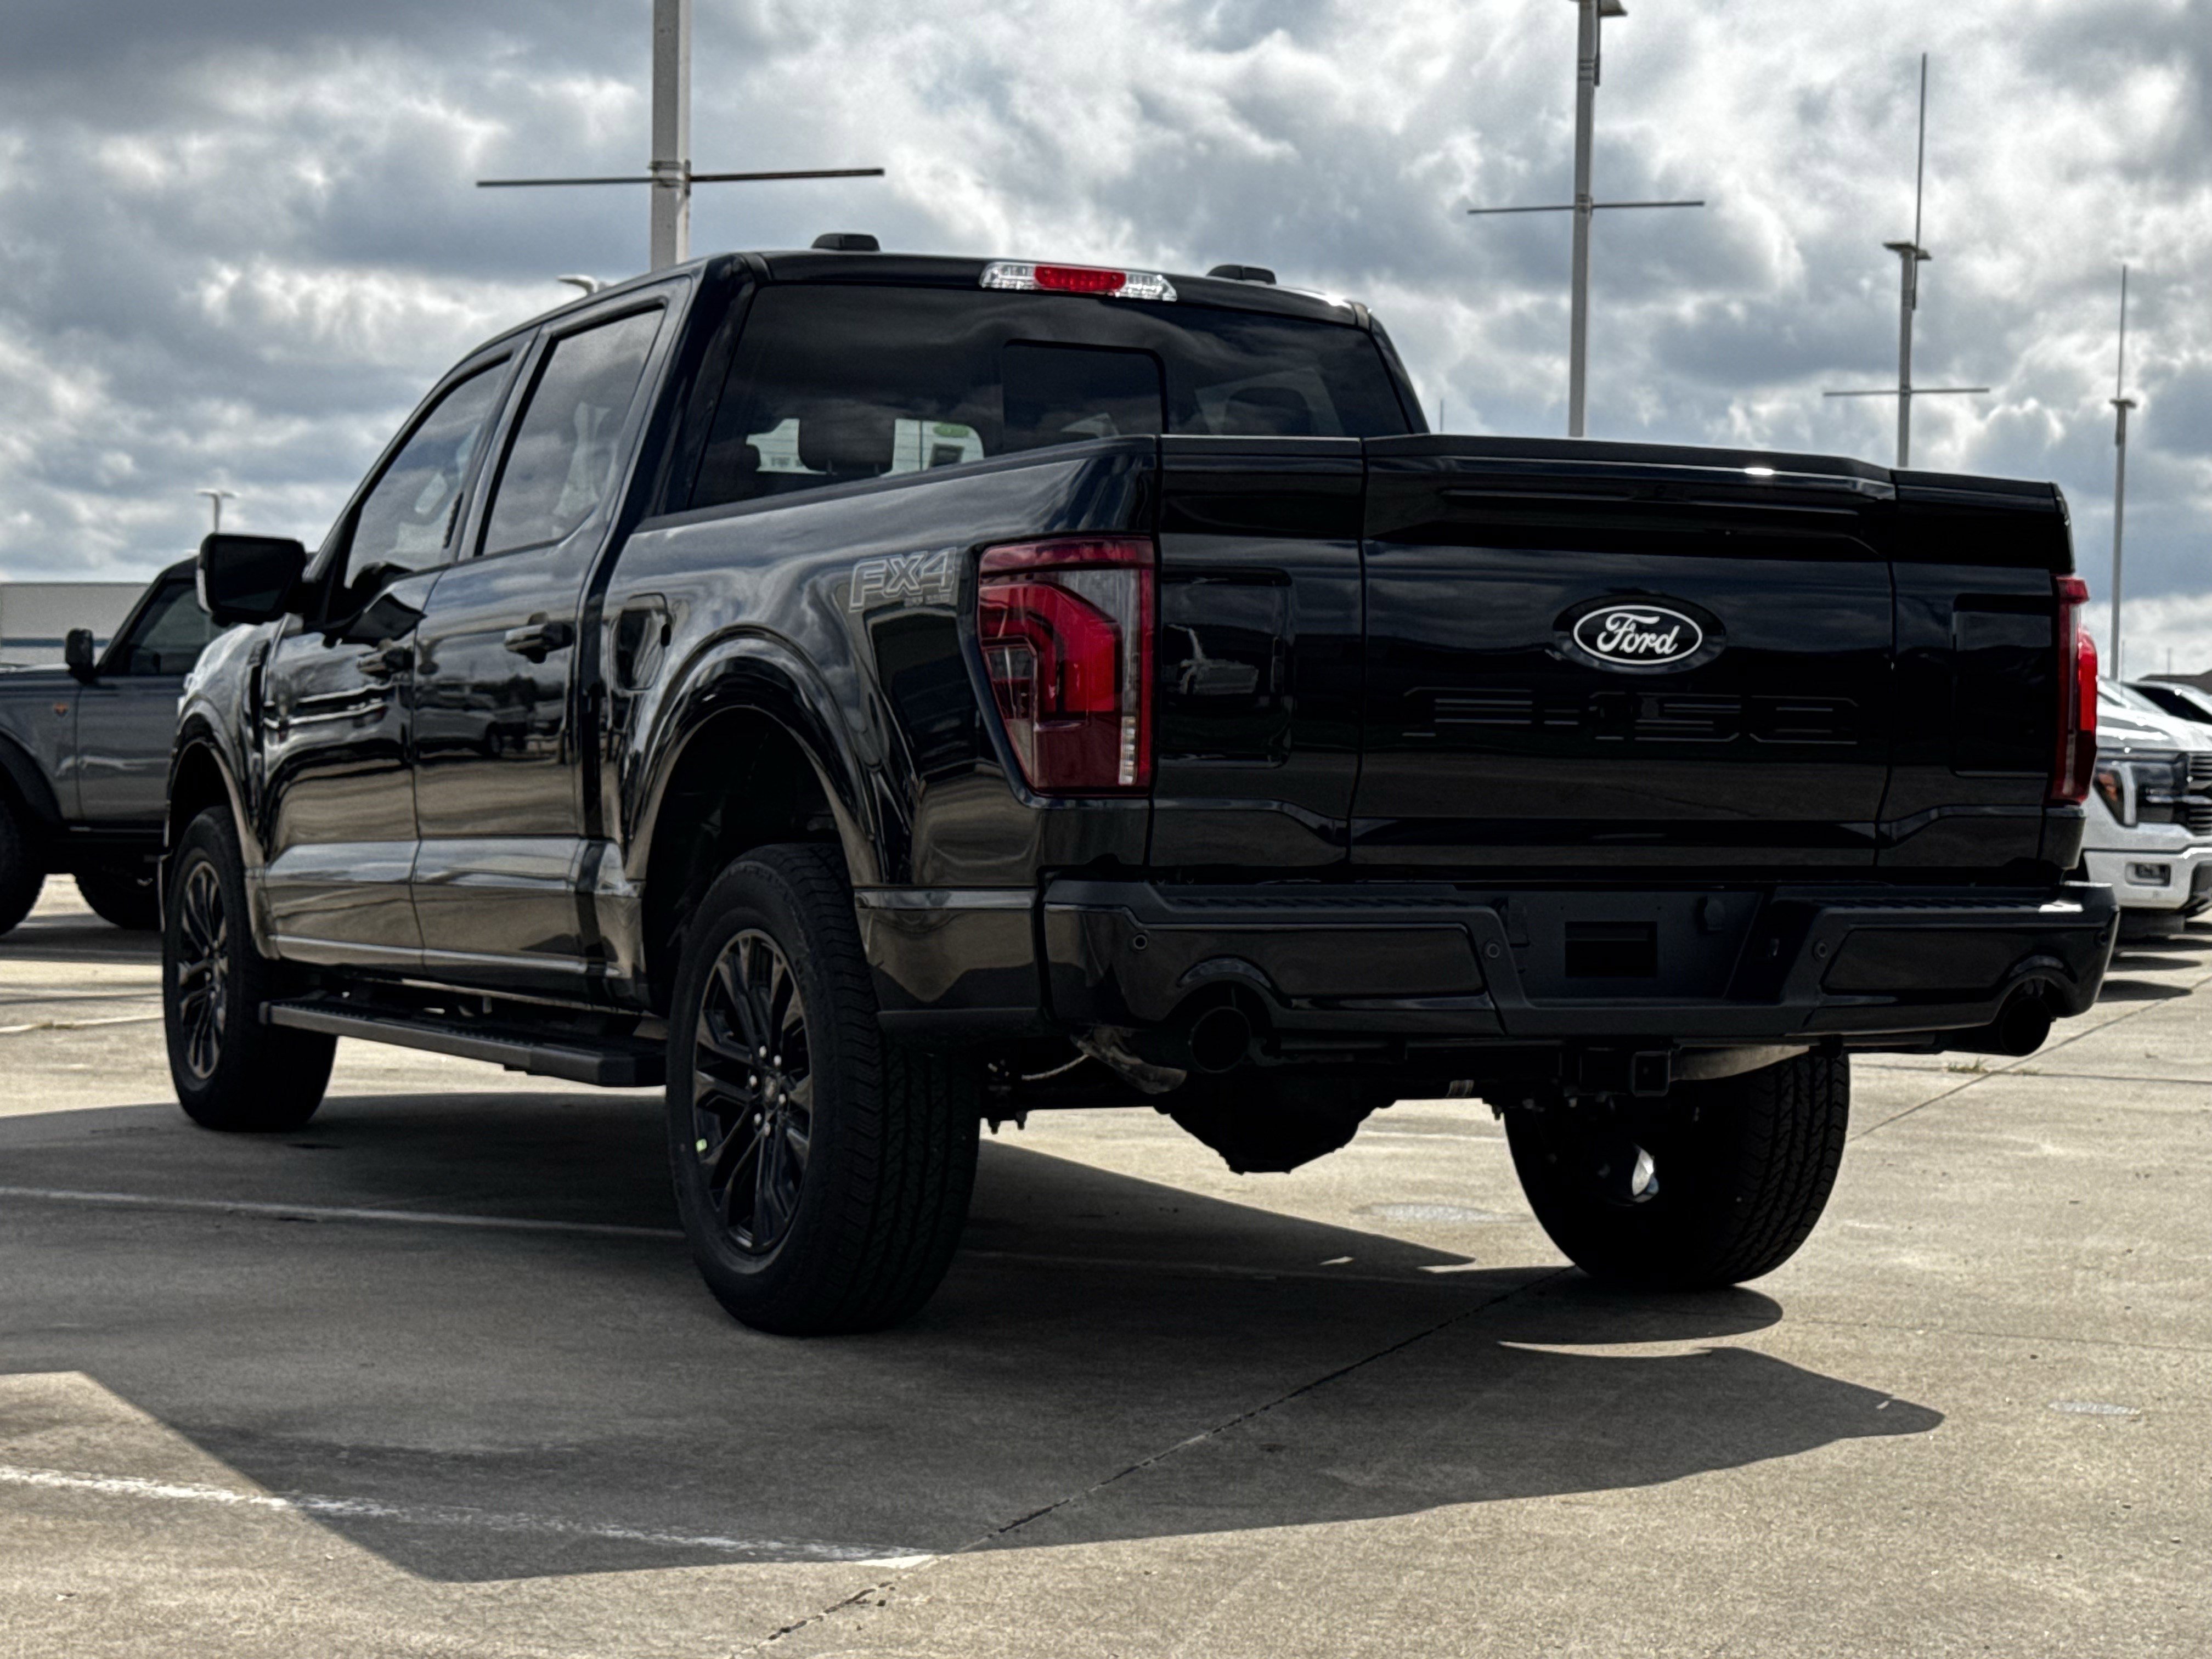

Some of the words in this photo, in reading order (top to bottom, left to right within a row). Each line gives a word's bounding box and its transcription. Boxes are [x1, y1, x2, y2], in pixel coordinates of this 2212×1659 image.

[849, 546, 957, 613] FX4
[1596, 612, 1680, 655] Ford
[1402, 687, 1859, 745] F-150
